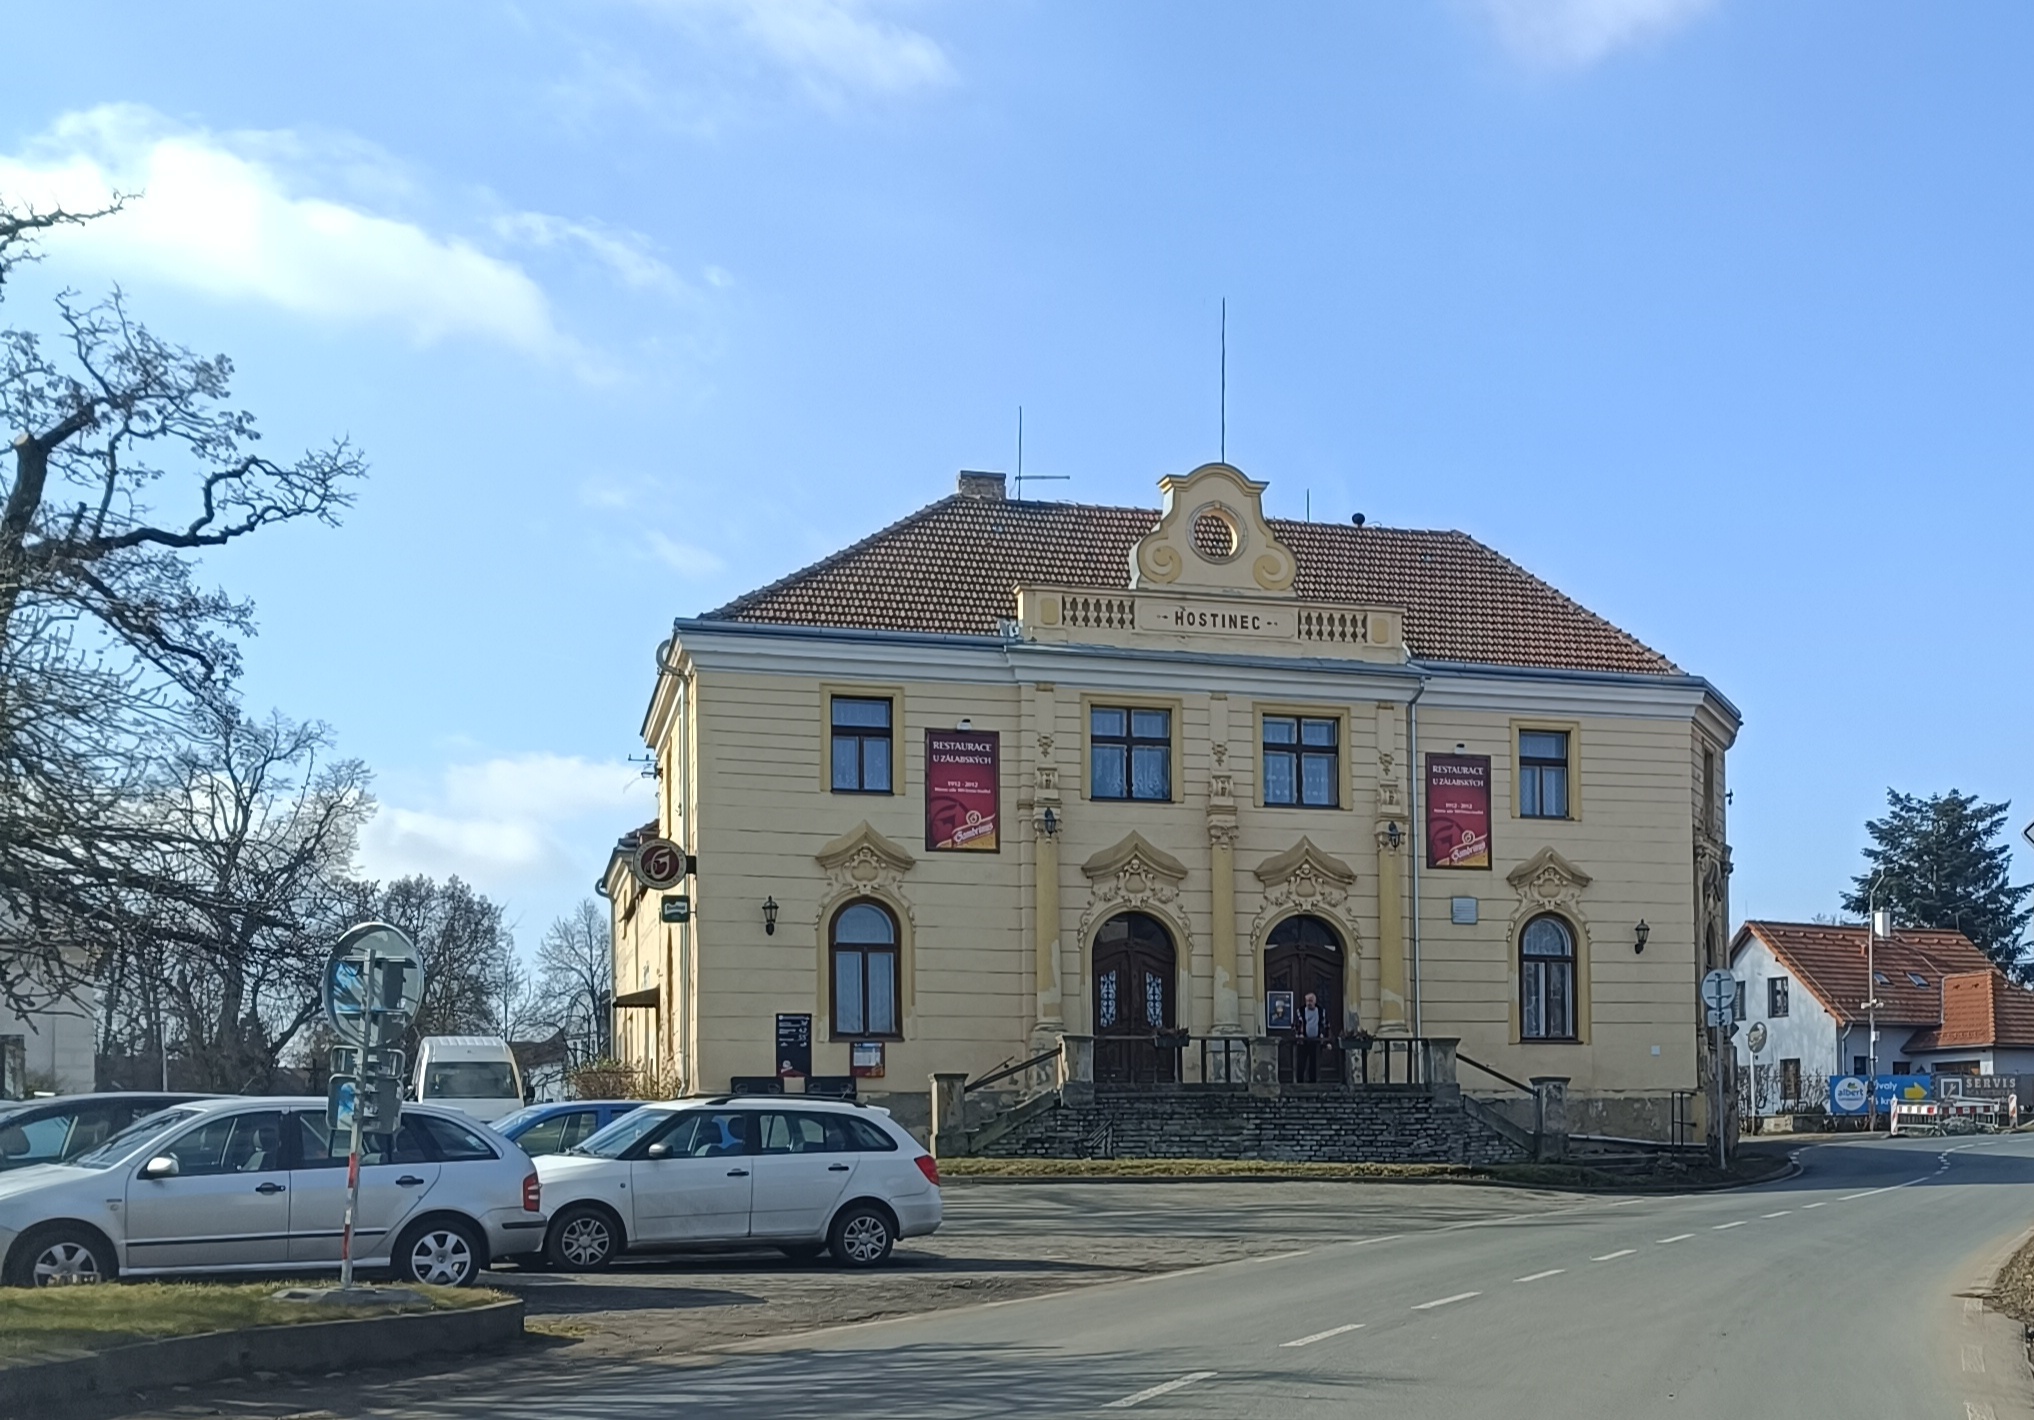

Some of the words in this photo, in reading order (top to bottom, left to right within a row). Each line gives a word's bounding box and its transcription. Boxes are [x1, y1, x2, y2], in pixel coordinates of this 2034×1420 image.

[1175, 610, 1260, 630] HOSTINEC
[933, 741, 992, 752] RESTAURACE
[932, 754, 939, 763] U
[1432, 765, 1484, 776] RESTAURACE
[1432, 778, 1438, 786] U
[1966, 1077, 2016, 1089] SERVIS
[1837, 1088, 1864, 1097] albert
